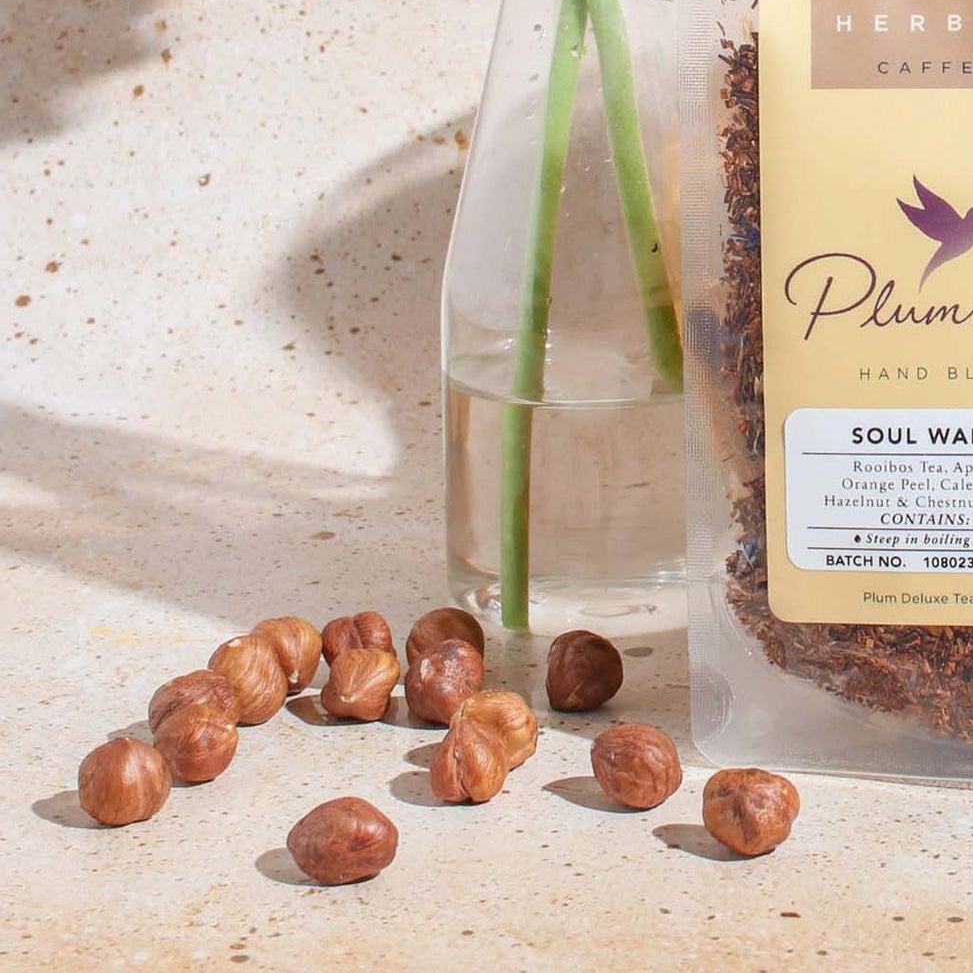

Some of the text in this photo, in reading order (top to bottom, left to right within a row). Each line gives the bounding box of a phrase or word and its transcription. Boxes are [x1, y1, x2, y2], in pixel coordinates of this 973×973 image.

[859, 366, 929, 381] HAND
[852, 427, 917, 445] SOUL
[853, 460, 913, 473] Rooibos
[920, 461, 948, 475] Tea,
[842, 478, 895, 493] Orange
[901, 478, 935, 492] Peel,
[824, 494, 890, 507] Hazelnut
[897, 495, 909, 508] &
[880, 512, 970, 526] CONTAINS:
[866, 533, 900, 547] Steep
[905, 534, 918, 545] in
[923, 534, 970, 548] boiling
[826, 555, 873, 568] BATCH
[878, 556, 906, 568] NO.
[863, 592, 897, 604] Plum
[901, 593, 949, 605] Deluxe
